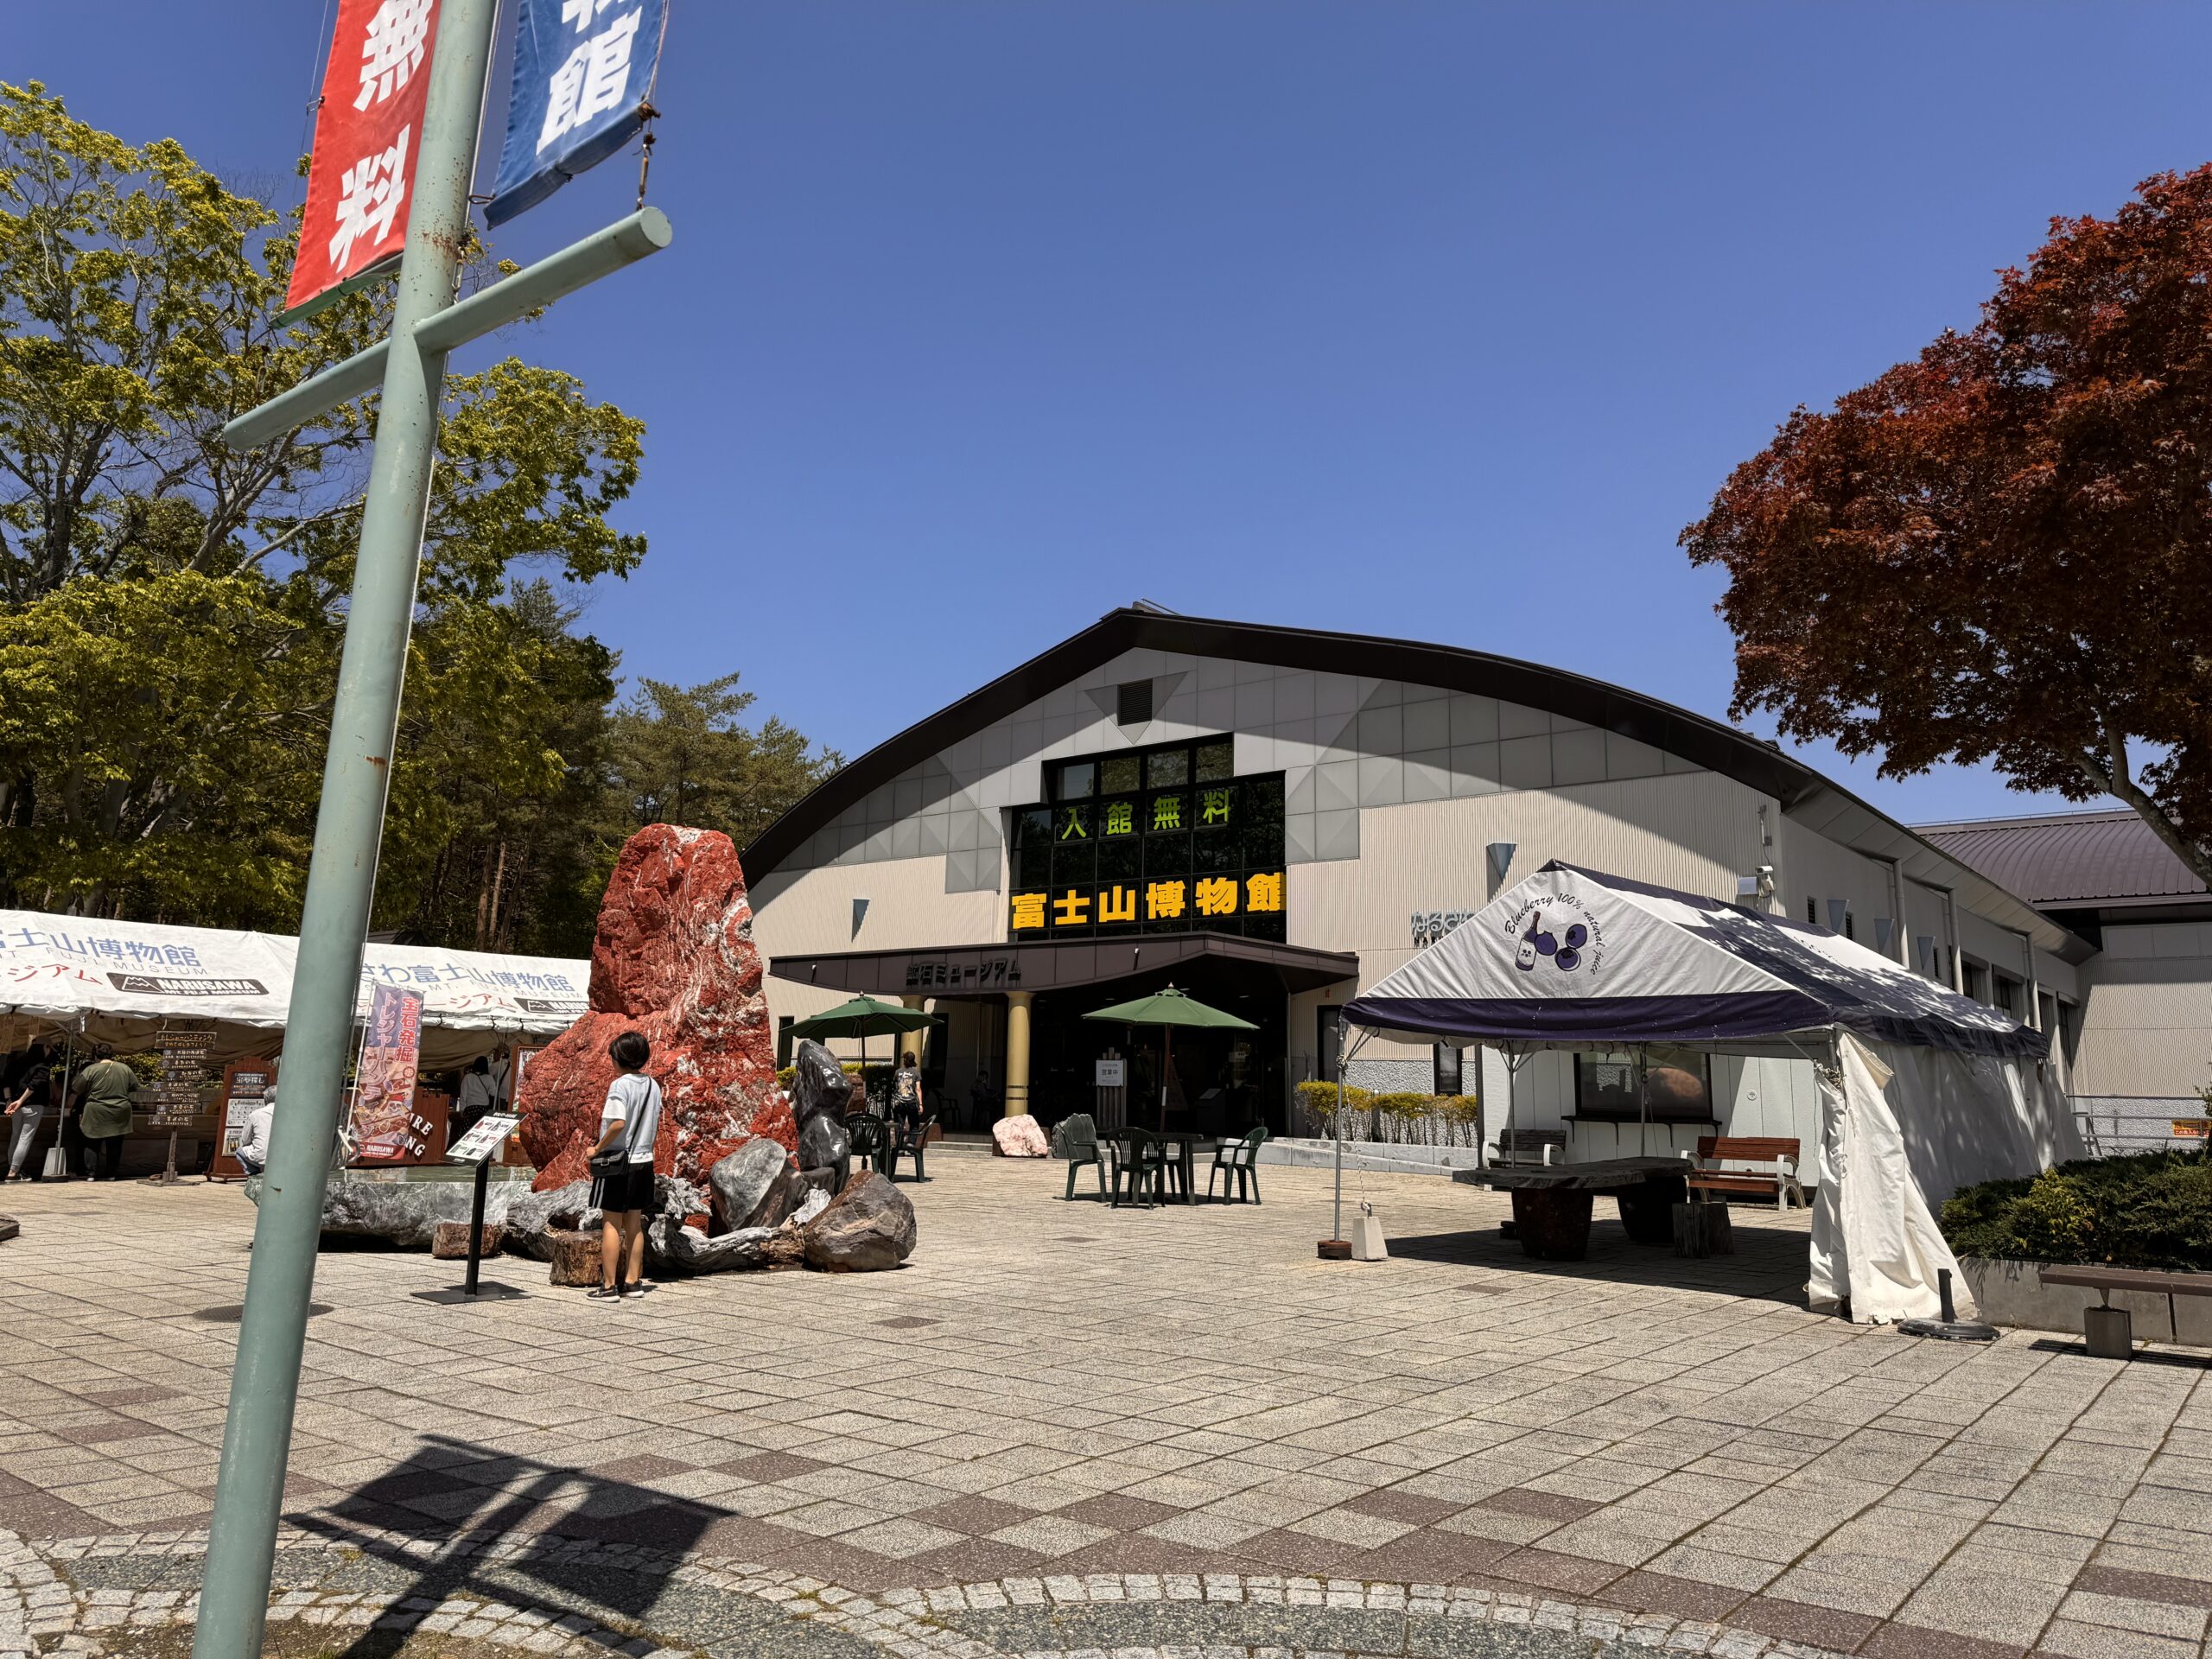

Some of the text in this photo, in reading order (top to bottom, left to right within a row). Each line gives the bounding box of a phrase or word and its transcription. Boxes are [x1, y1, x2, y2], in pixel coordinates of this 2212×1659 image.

[536, 0, 642, 156] 館
[328, 0, 430, 274] 無料
[1061, 788, 1231, 841] 入館無料
[1011, 872, 1287, 930] 富士山博物館
[0, 927, 202, 967] 士山博物館
[1504, 893, 1605, 976] Blueberry 100% natural juice
[0, 963, 103, 985] ジアム
[114, 961, 208, 976] MUSEUM
[156, 978, 257, 990] NARUSAWA
[395, 995, 420, 1063] 宝石発掘
